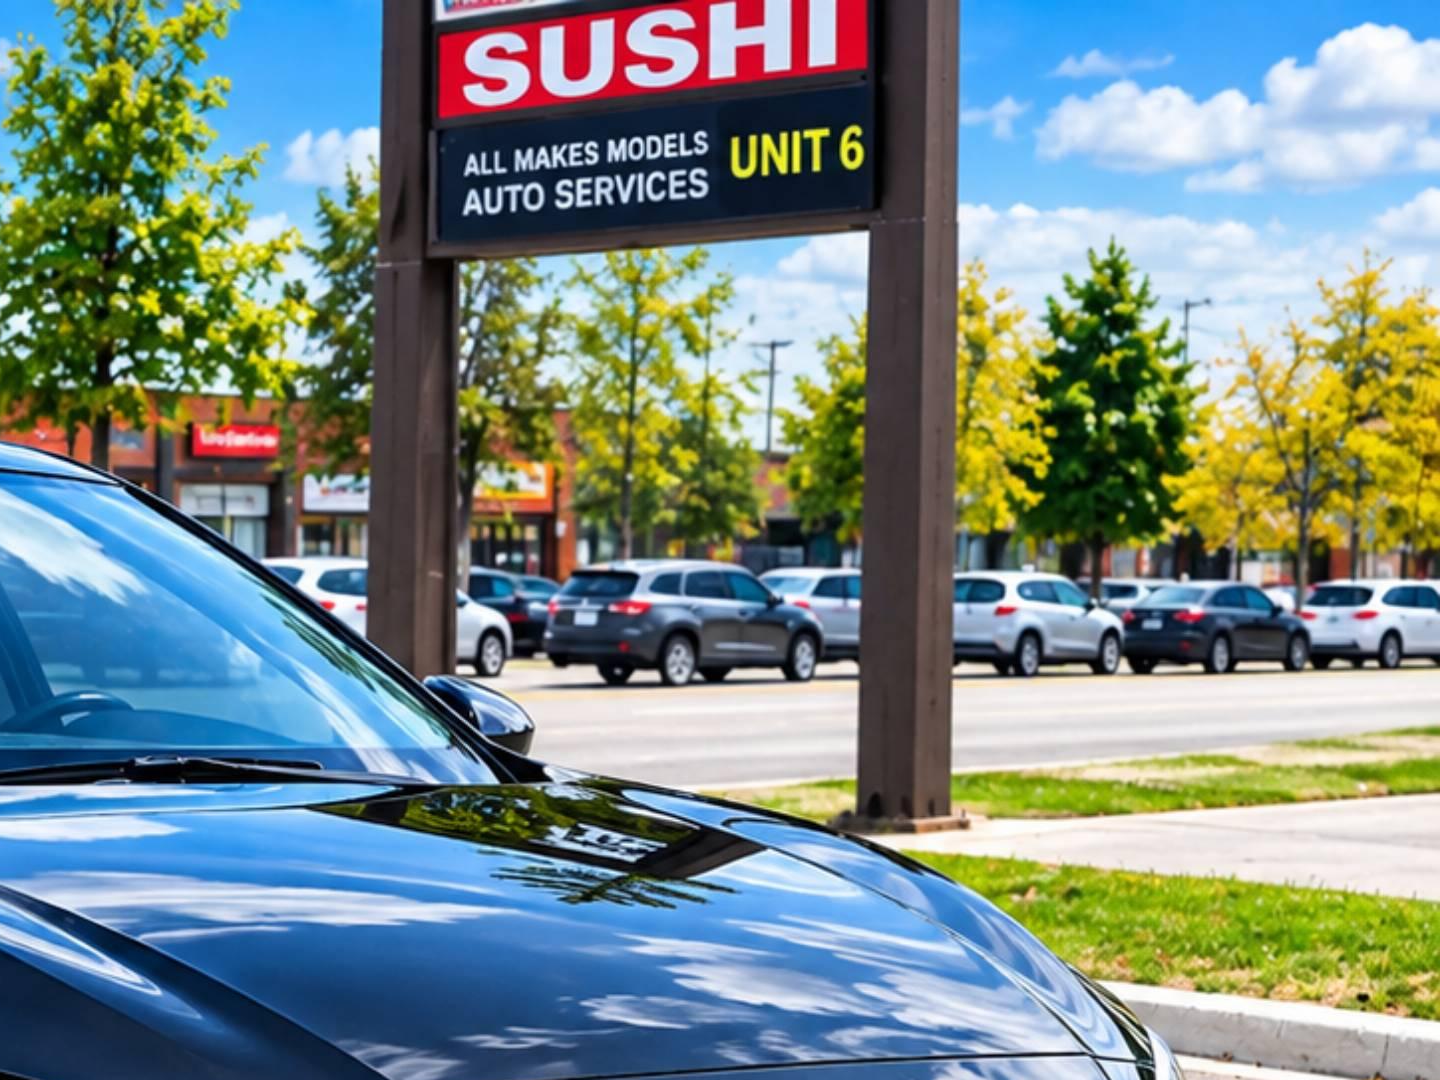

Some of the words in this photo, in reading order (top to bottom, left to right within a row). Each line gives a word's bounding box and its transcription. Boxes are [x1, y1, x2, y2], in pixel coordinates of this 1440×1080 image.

[462, 0, 838, 107] SUSHI
[463, 148, 507, 177] ALL
[513, 139, 600, 173] MAKES
[607, 130, 709, 163] MODELS
[729, 128, 831, 179] UNIT
[838, 124, 865, 171] 6
[462, 182, 546, 217] AUTO
[554, 168, 709, 209] SERVICES
